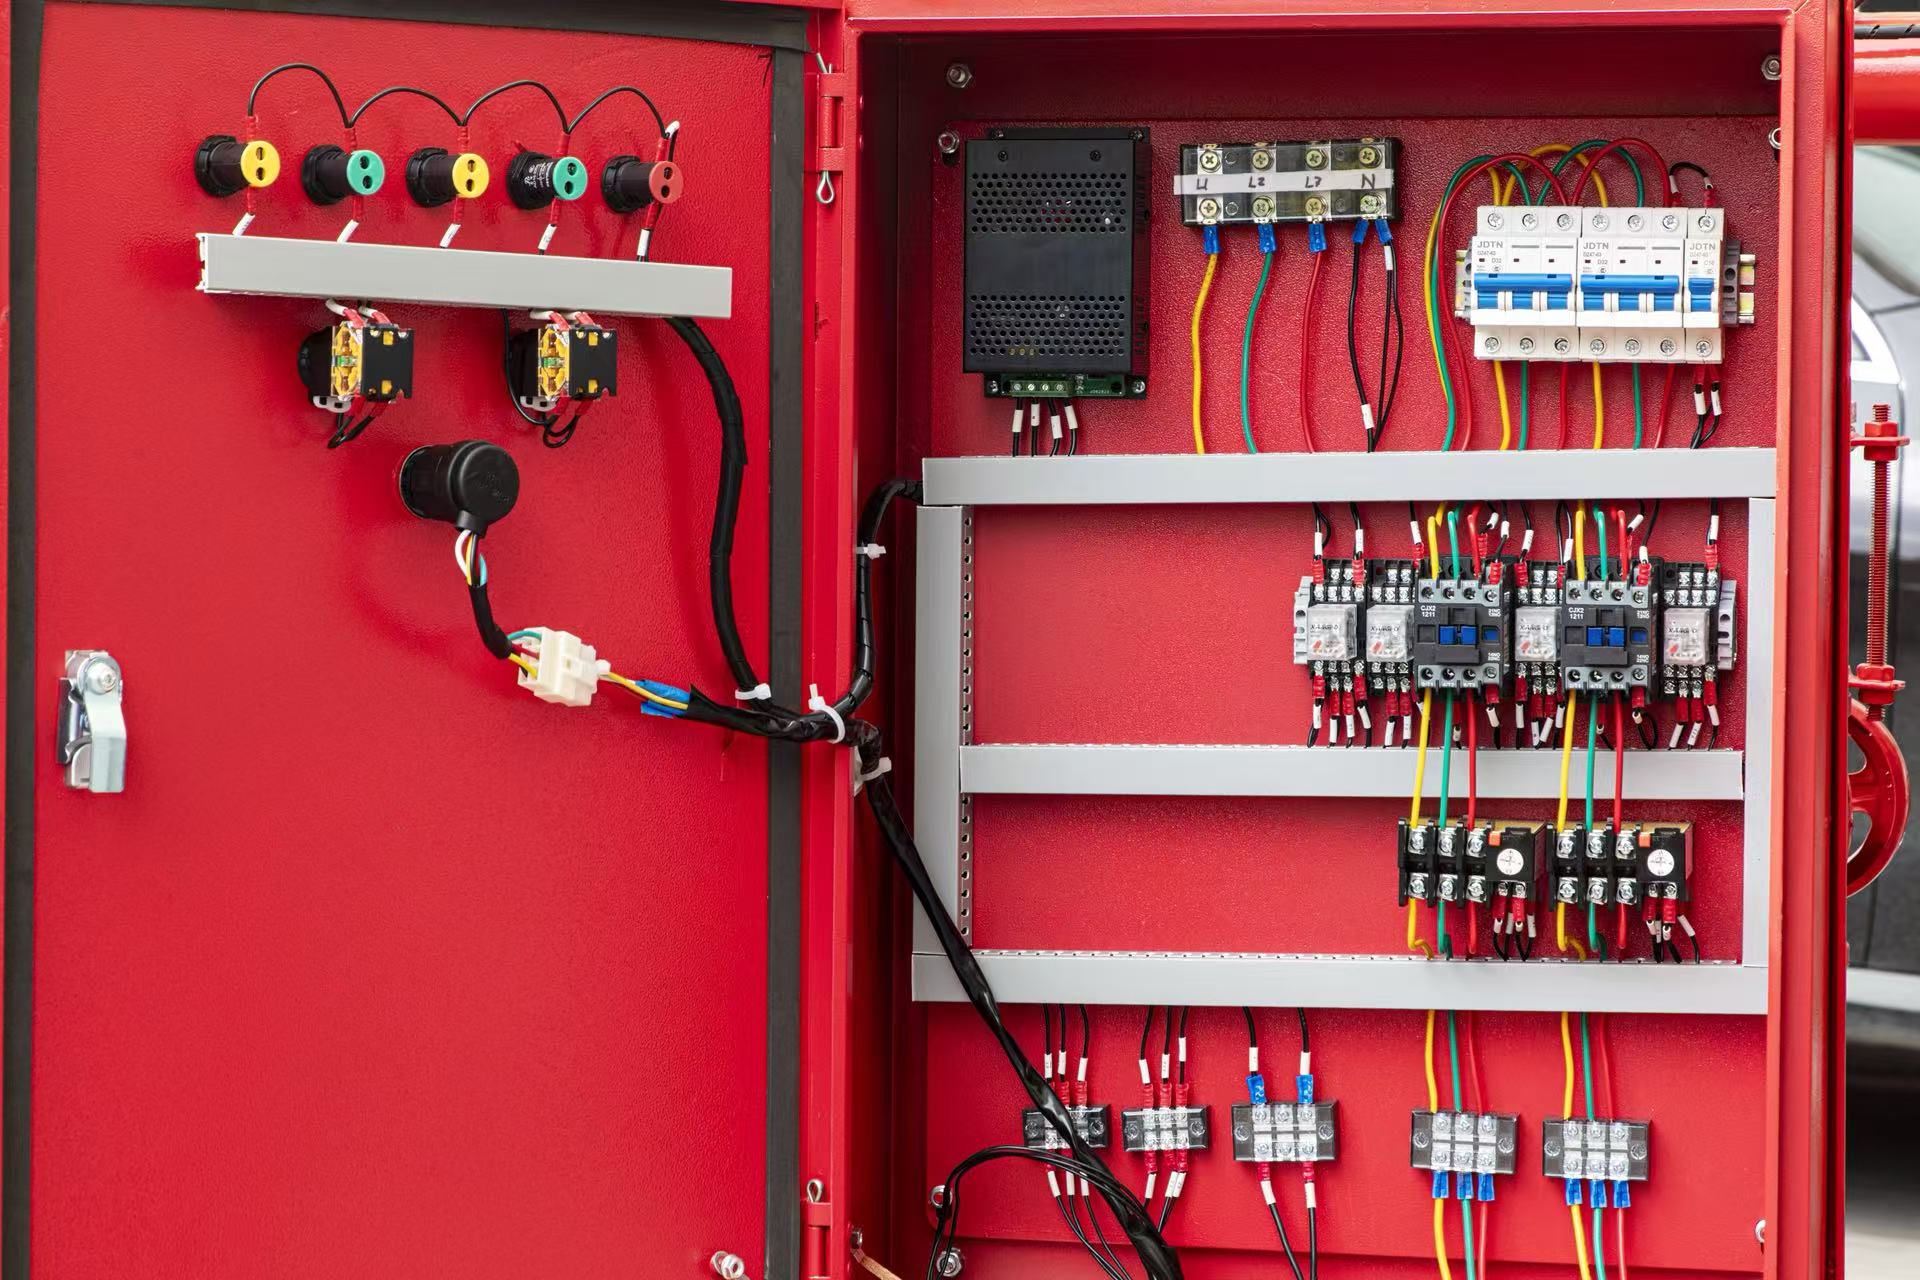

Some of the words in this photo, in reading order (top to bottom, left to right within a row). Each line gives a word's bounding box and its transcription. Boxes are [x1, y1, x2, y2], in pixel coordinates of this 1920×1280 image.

[1248, 175, 1265, 188] L2
[1360, 173, 1375, 191] N
[1477, 241, 1503, 249] JDTN
[1583, 242, 1609, 250] JDTN
[1689, 243, 1716, 251] JDTN
